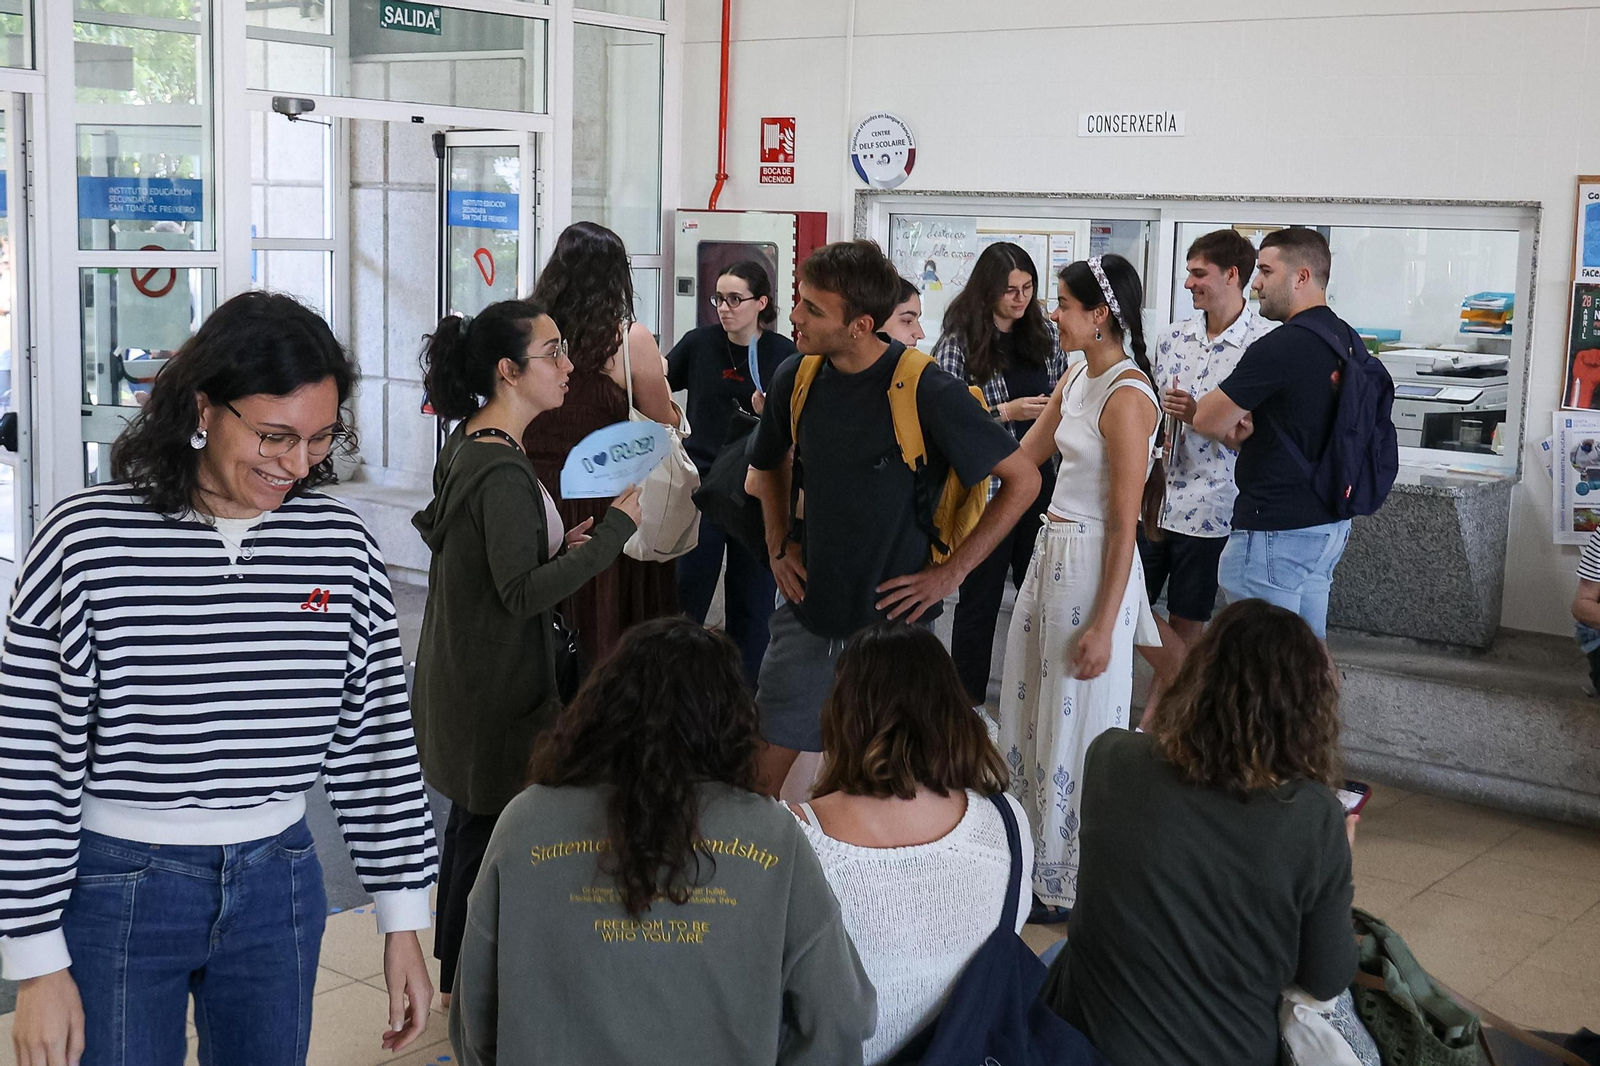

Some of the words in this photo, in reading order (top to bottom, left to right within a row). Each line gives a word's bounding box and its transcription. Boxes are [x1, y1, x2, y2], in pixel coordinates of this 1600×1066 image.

[384, 5, 437, 29] SALIDA
[1087, 111, 1177, 133] CONSERXERÍA
[871, 129, 891, 137] CENTRE
[859, 141, 875, 150] DELF
[875, 138, 906, 148] SCOLAIRE
[762, 167, 781, 175] BOCA
[782, 167, 791, 175] DE
[761, 175, 792, 183] INCENDIO
[108, 186, 148, 195] INSTITUTO
[108, 195, 154, 204] SECUNDARIA
[109, 204, 124, 212] SAN
[148, 204, 158, 213] DE
[594, 919, 664, 932] FREEDOM
[668, 920, 687, 932] TO
[692, 920, 711, 933] BE
[601, 930, 637, 943] WHO
[641, 930, 671, 943] YOU
[676, 931, 704, 943] ARE
